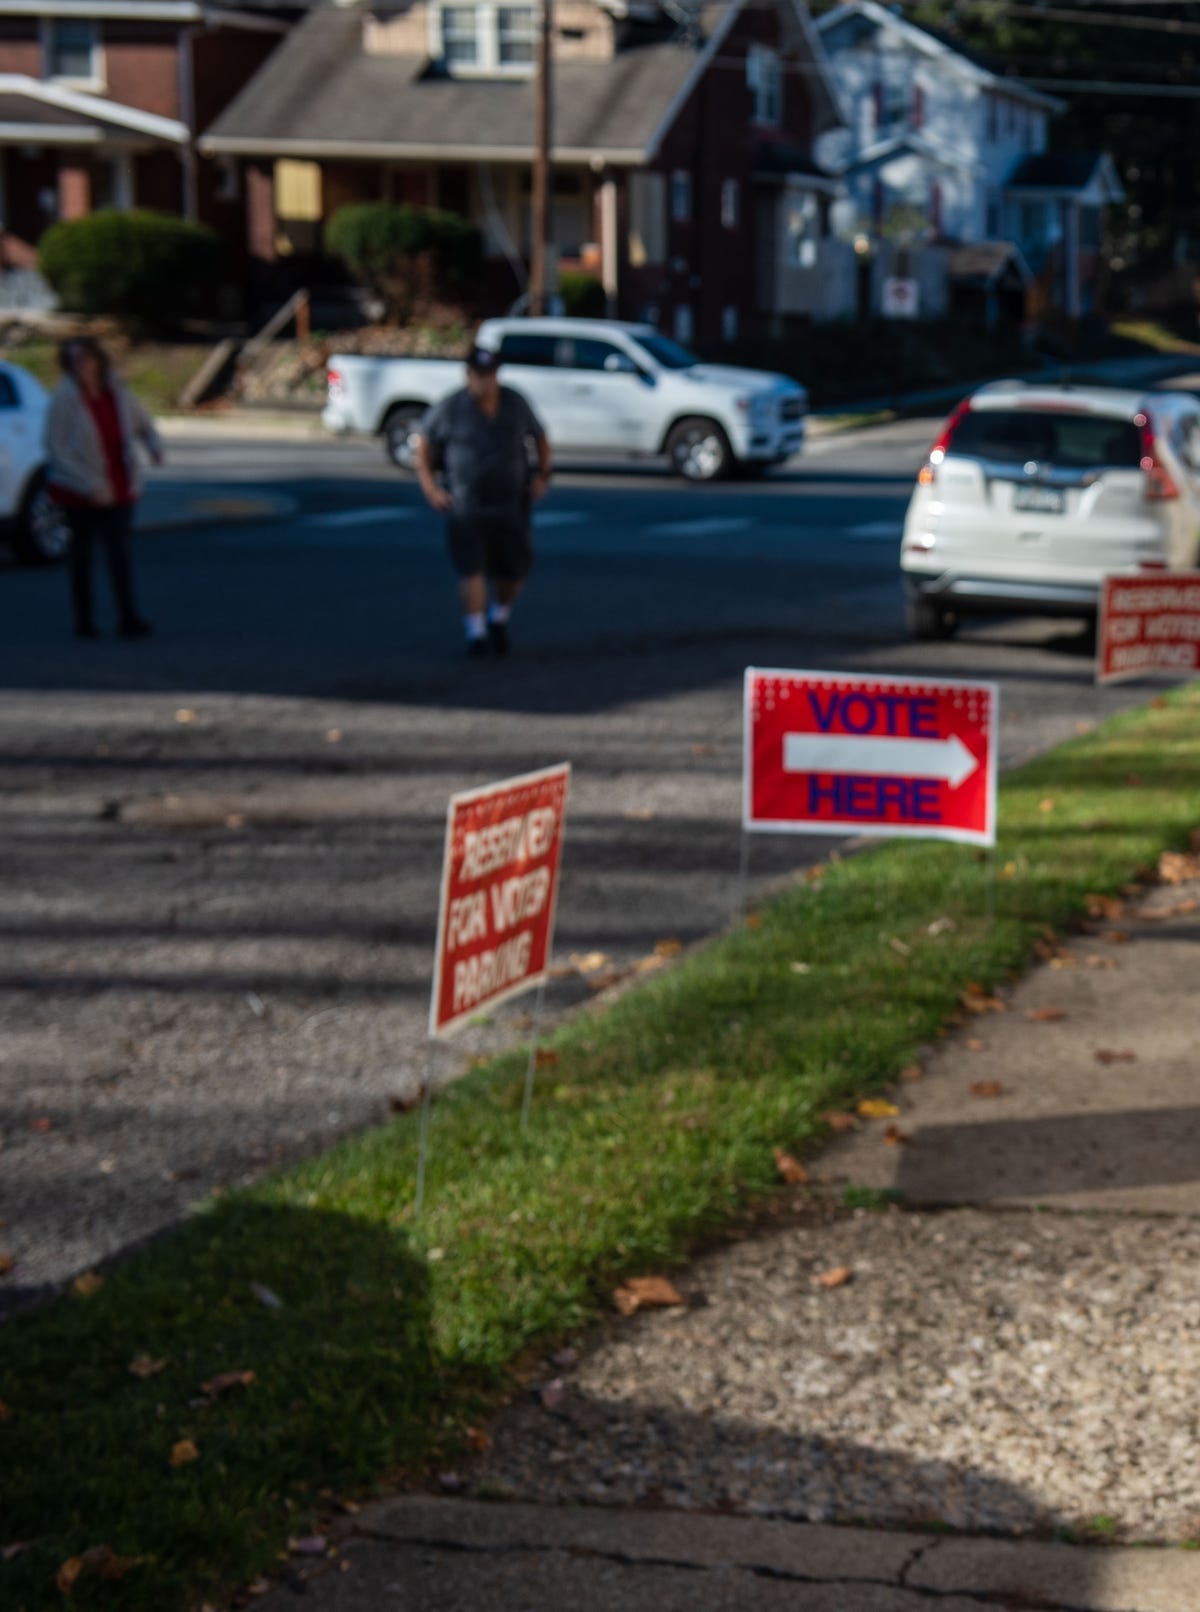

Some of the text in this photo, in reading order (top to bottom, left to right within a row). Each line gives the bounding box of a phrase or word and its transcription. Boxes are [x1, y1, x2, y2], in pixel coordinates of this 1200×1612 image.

[808, 691, 940, 738] VOTE
[808, 774, 941, 820] HERE
[460, 805, 556, 882] RESERVED
[448, 864, 550, 950] FOR VOTER
[453, 929, 533, 1012] PARKING
